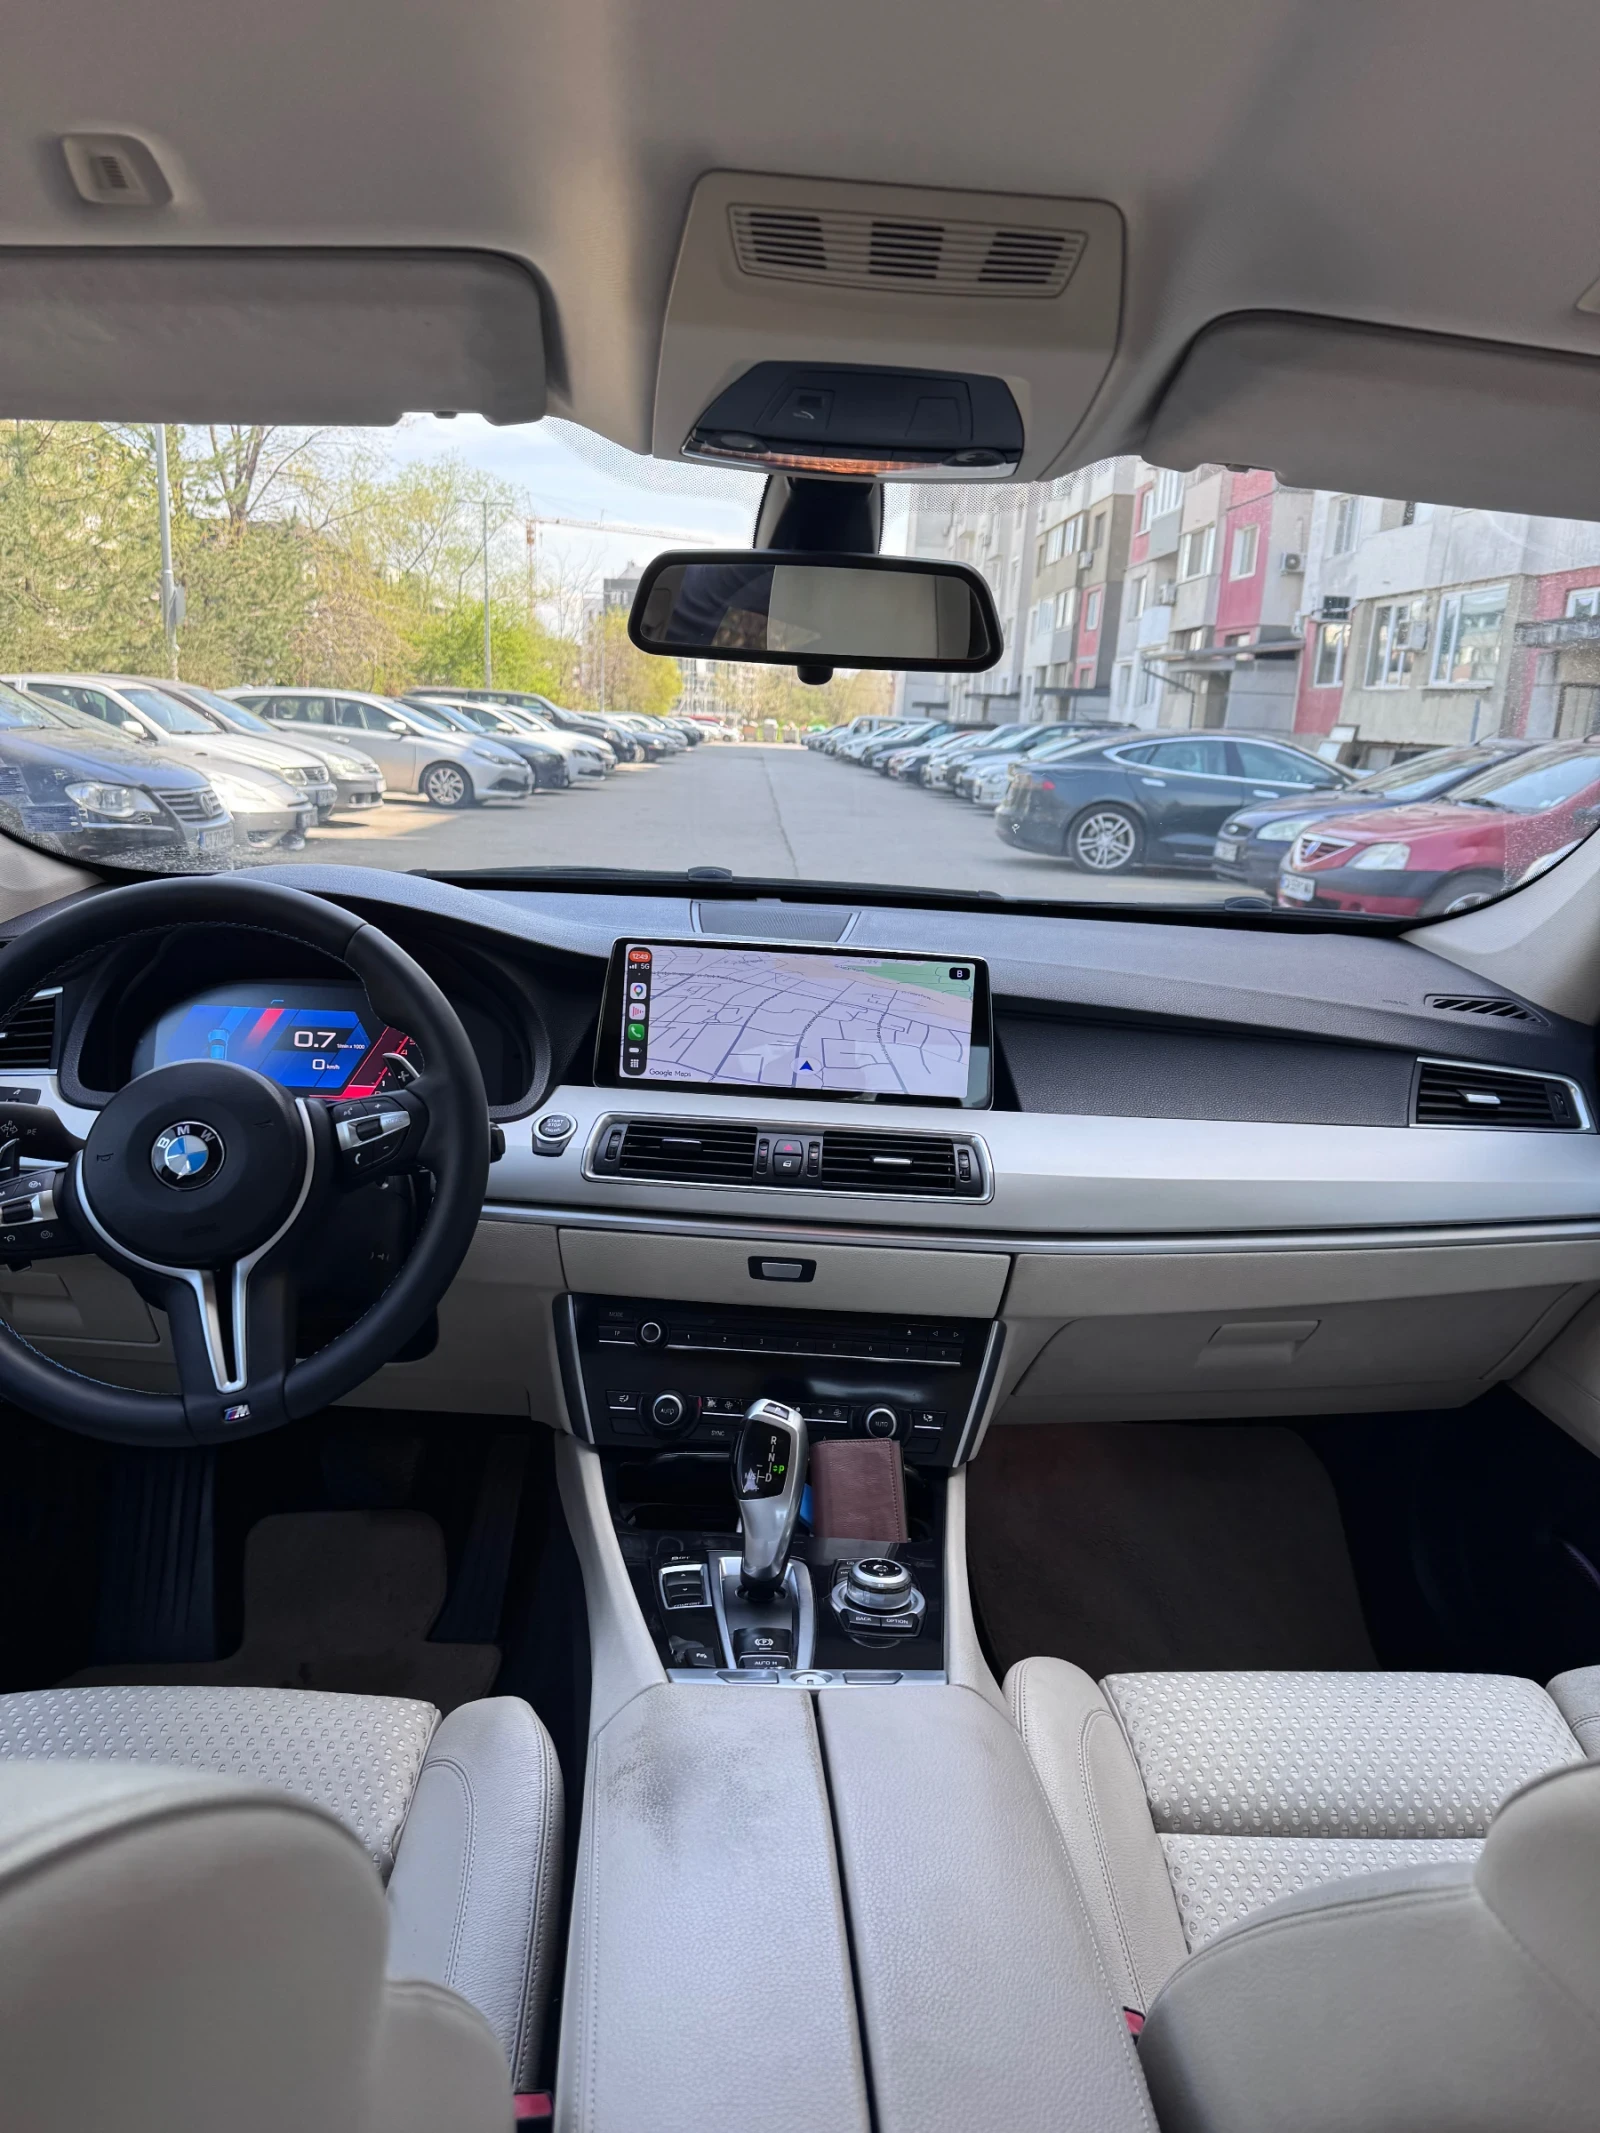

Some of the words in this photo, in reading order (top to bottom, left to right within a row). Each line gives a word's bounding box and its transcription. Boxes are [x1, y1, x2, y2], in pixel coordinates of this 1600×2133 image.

[956, 969, 963, 978] B
[294, 1031, 336, 1048] 0.7
[312, 1059, 325, 1070] 0
[649, 1068, 673, 1077] Google
[157, 1125, 216, 1149] BMW
[770, 1435, 777, 1445] R
[767, 1453, 775, 1462] N
[778, 1465, 785, 1474] P
[765, 1473, 772, 1482] D
